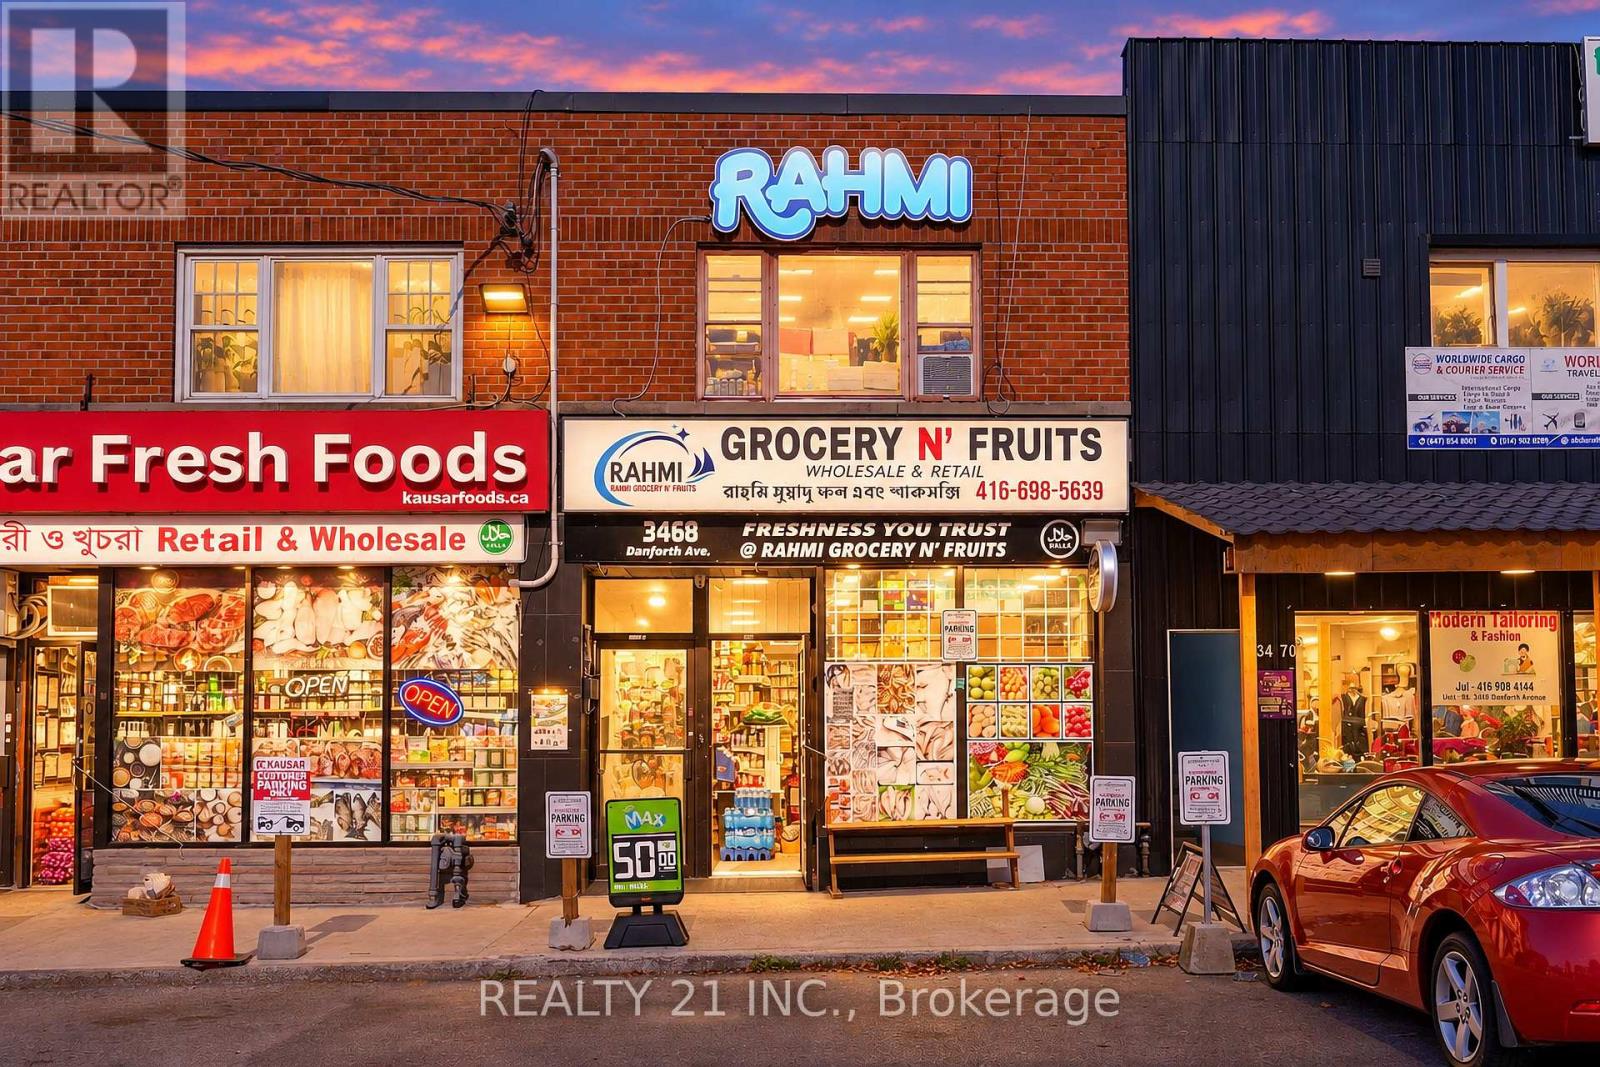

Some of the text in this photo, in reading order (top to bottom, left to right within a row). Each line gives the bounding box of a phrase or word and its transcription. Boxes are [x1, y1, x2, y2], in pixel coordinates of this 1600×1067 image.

[711, 147, 971, 238] RAHMI
[1436, 354, 1525, 363] WORLDWIDE CARGO
[1436, 365, 1524, 374] & COURIER SERVICE
[721, 427, 1102, 461] GROCERY N' FRUITS
[91, 431, 288, 485] Fresh
[314, 431, 528, 484] Foods
[610, 462, 682, 482] RAHMI
[806, 465, 984, 478] WHOLESALE & RETAIL
[402, 491, 529, 504] kausarfoods.ca
[976, 481, 1103, 501] 416-698-5639
[643, 521, 699, 543] 3468
[742, 523, 1012, 537] FRESHNESS YOU TRUST
[73, 526, 143, 558] খুচরা
[158, 526, 466, 552] Retail & Wholesale
[626, 546, 711, 559] Danforth Ave.
[740, 542, 1007, 559] @ RAHMI GROCERY N' FRUITS
[1429, 610, 1558, 632] Modern Tailoring
[1470, 630, 1521, 641] & Fashion
[1257, 644, 1273, 658] 34
[285, 675, 349, 698] OPEN
[1477, 682, 1492, 691] 416
[1495, 682, 1511, 691] 908
[1514, 682, 1534, 691] 4144
[404, 684, 457, 719] OPEN
[1185, 775, 1224, 786] PARKING
[1095, 797, 1130, 808] PARKING
[551, 813, 586, 823] PARKING
[613, 841, 655, 879] 50
